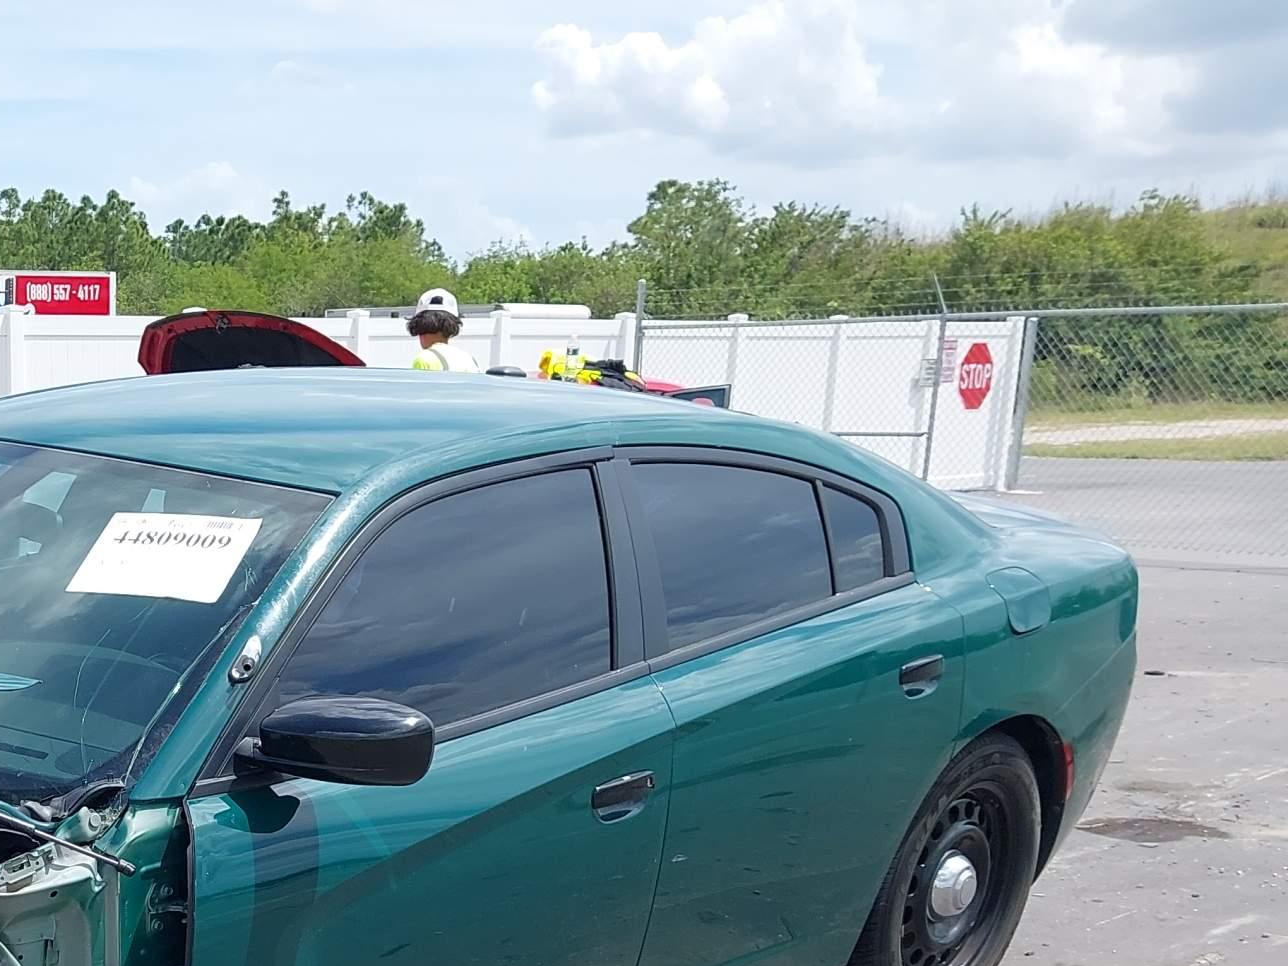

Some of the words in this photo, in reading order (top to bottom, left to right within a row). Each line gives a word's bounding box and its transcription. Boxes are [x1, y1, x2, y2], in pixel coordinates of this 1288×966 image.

[26, 281, 52, 303] (888)
[959, 363, 992, 390] STOP
[113, 530, 232, 549] 44809009
